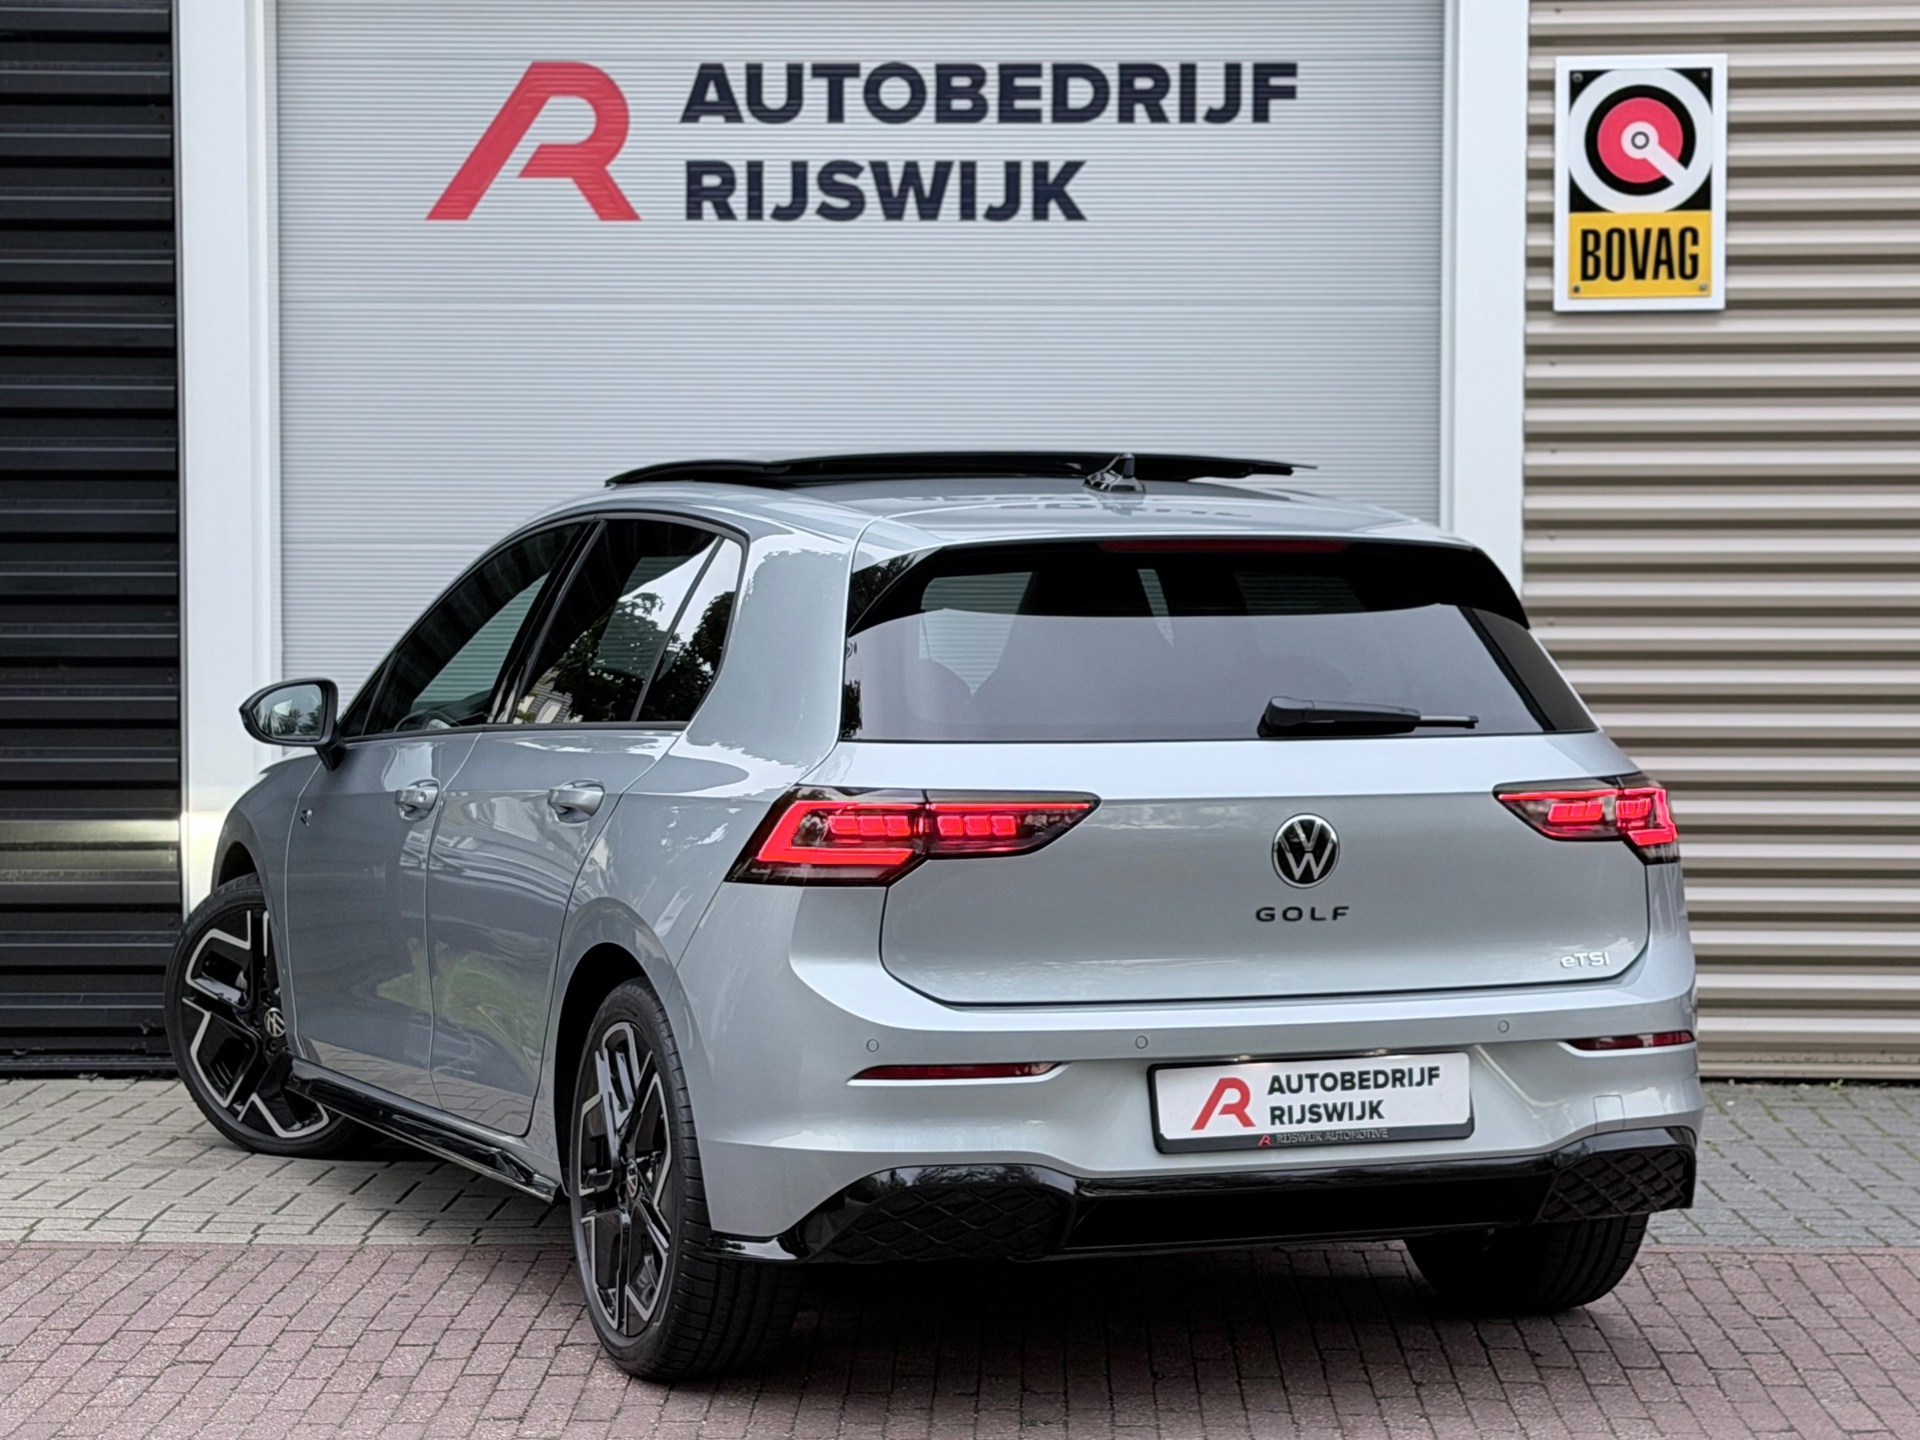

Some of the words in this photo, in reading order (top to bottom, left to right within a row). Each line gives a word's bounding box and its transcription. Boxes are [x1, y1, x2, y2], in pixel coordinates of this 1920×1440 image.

[680, 61, 1298, 124] AUTOBEDRIJF
[685, 159, 1087, 221] RIJSWIJK
[1580, 226, 1700, 282] BOVAG
[1255, 905, 1350, 922] GOLF
[1267, 1066, 1441, 1095] AUTOBEDRIJF
[1269, 1099, 1385, 1126] RIJSWIJK
[1276, 1131, 1323, 1144] RIJSWIJK
[1324, 1128, 1389, 1141] AUTOMOTIVE
